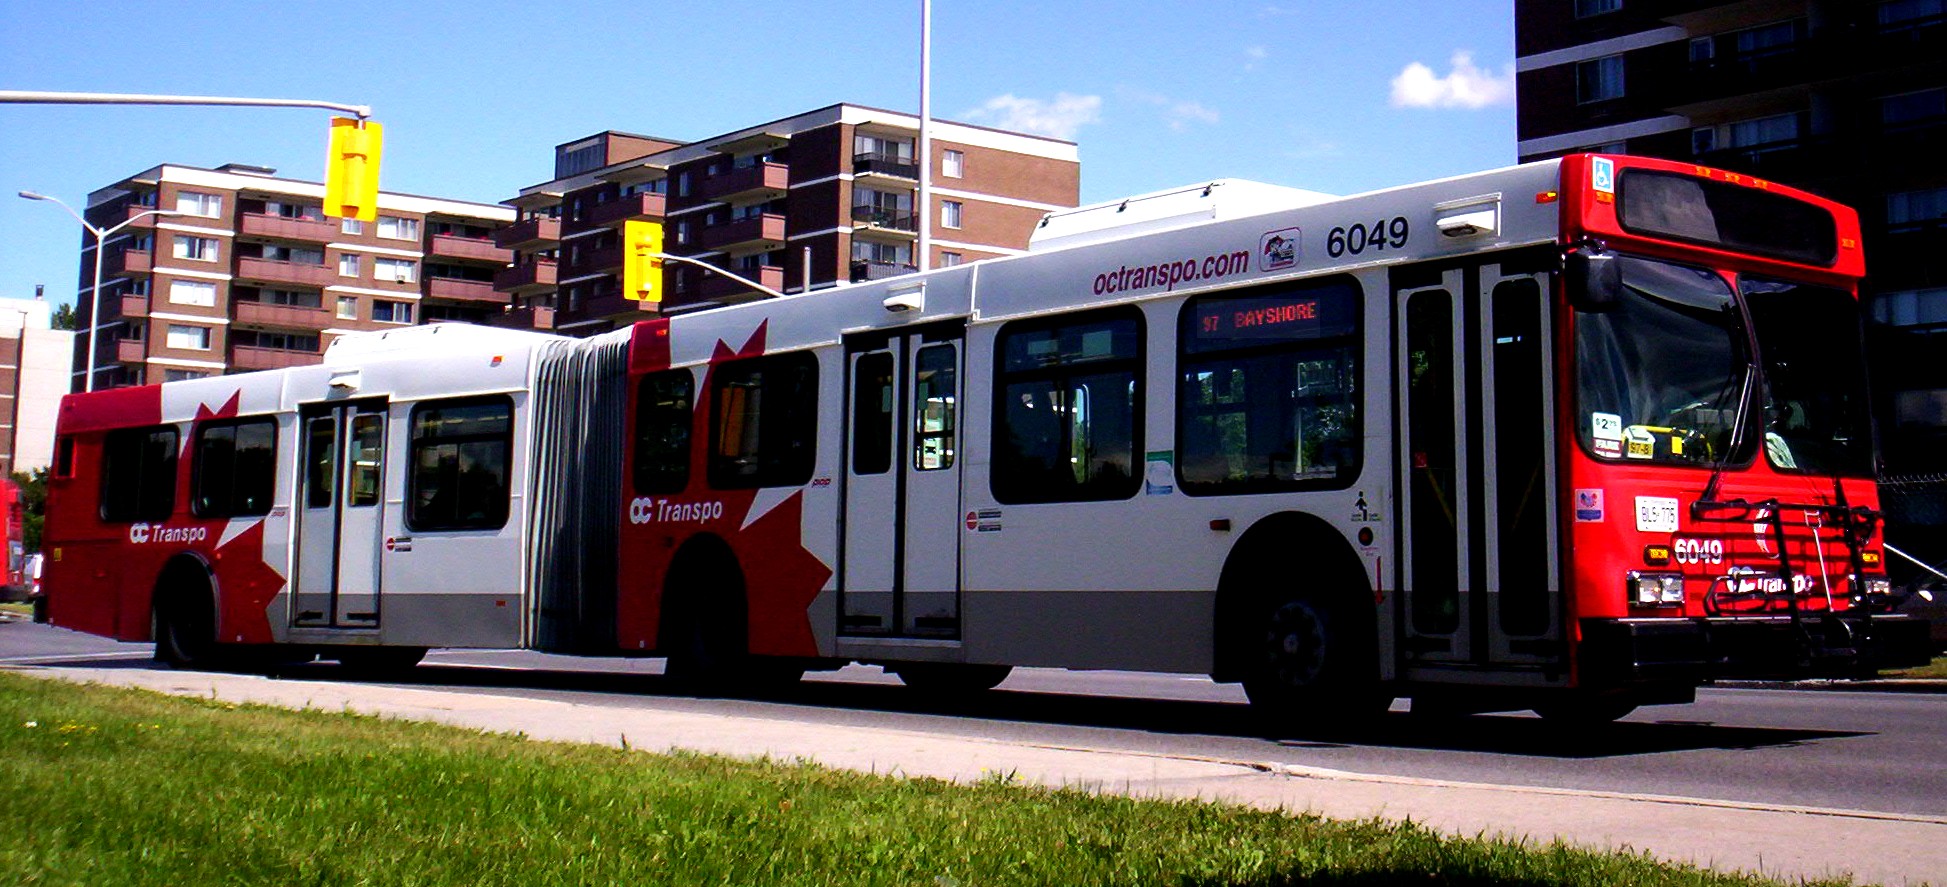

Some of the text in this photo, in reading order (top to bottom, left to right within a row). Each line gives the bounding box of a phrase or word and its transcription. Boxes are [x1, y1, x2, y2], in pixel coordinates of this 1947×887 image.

[1326, 216, 1409, 258] 6049
[1092, 249, 1250, 295] octranspo.com
[1233, 301, 1317, 328] BAYSHORE
[629, 497, 723, 525] OC Transpo
[129, 522, 207, 545] OC Transpo
[1674, 538, 1723, 565] 6049
